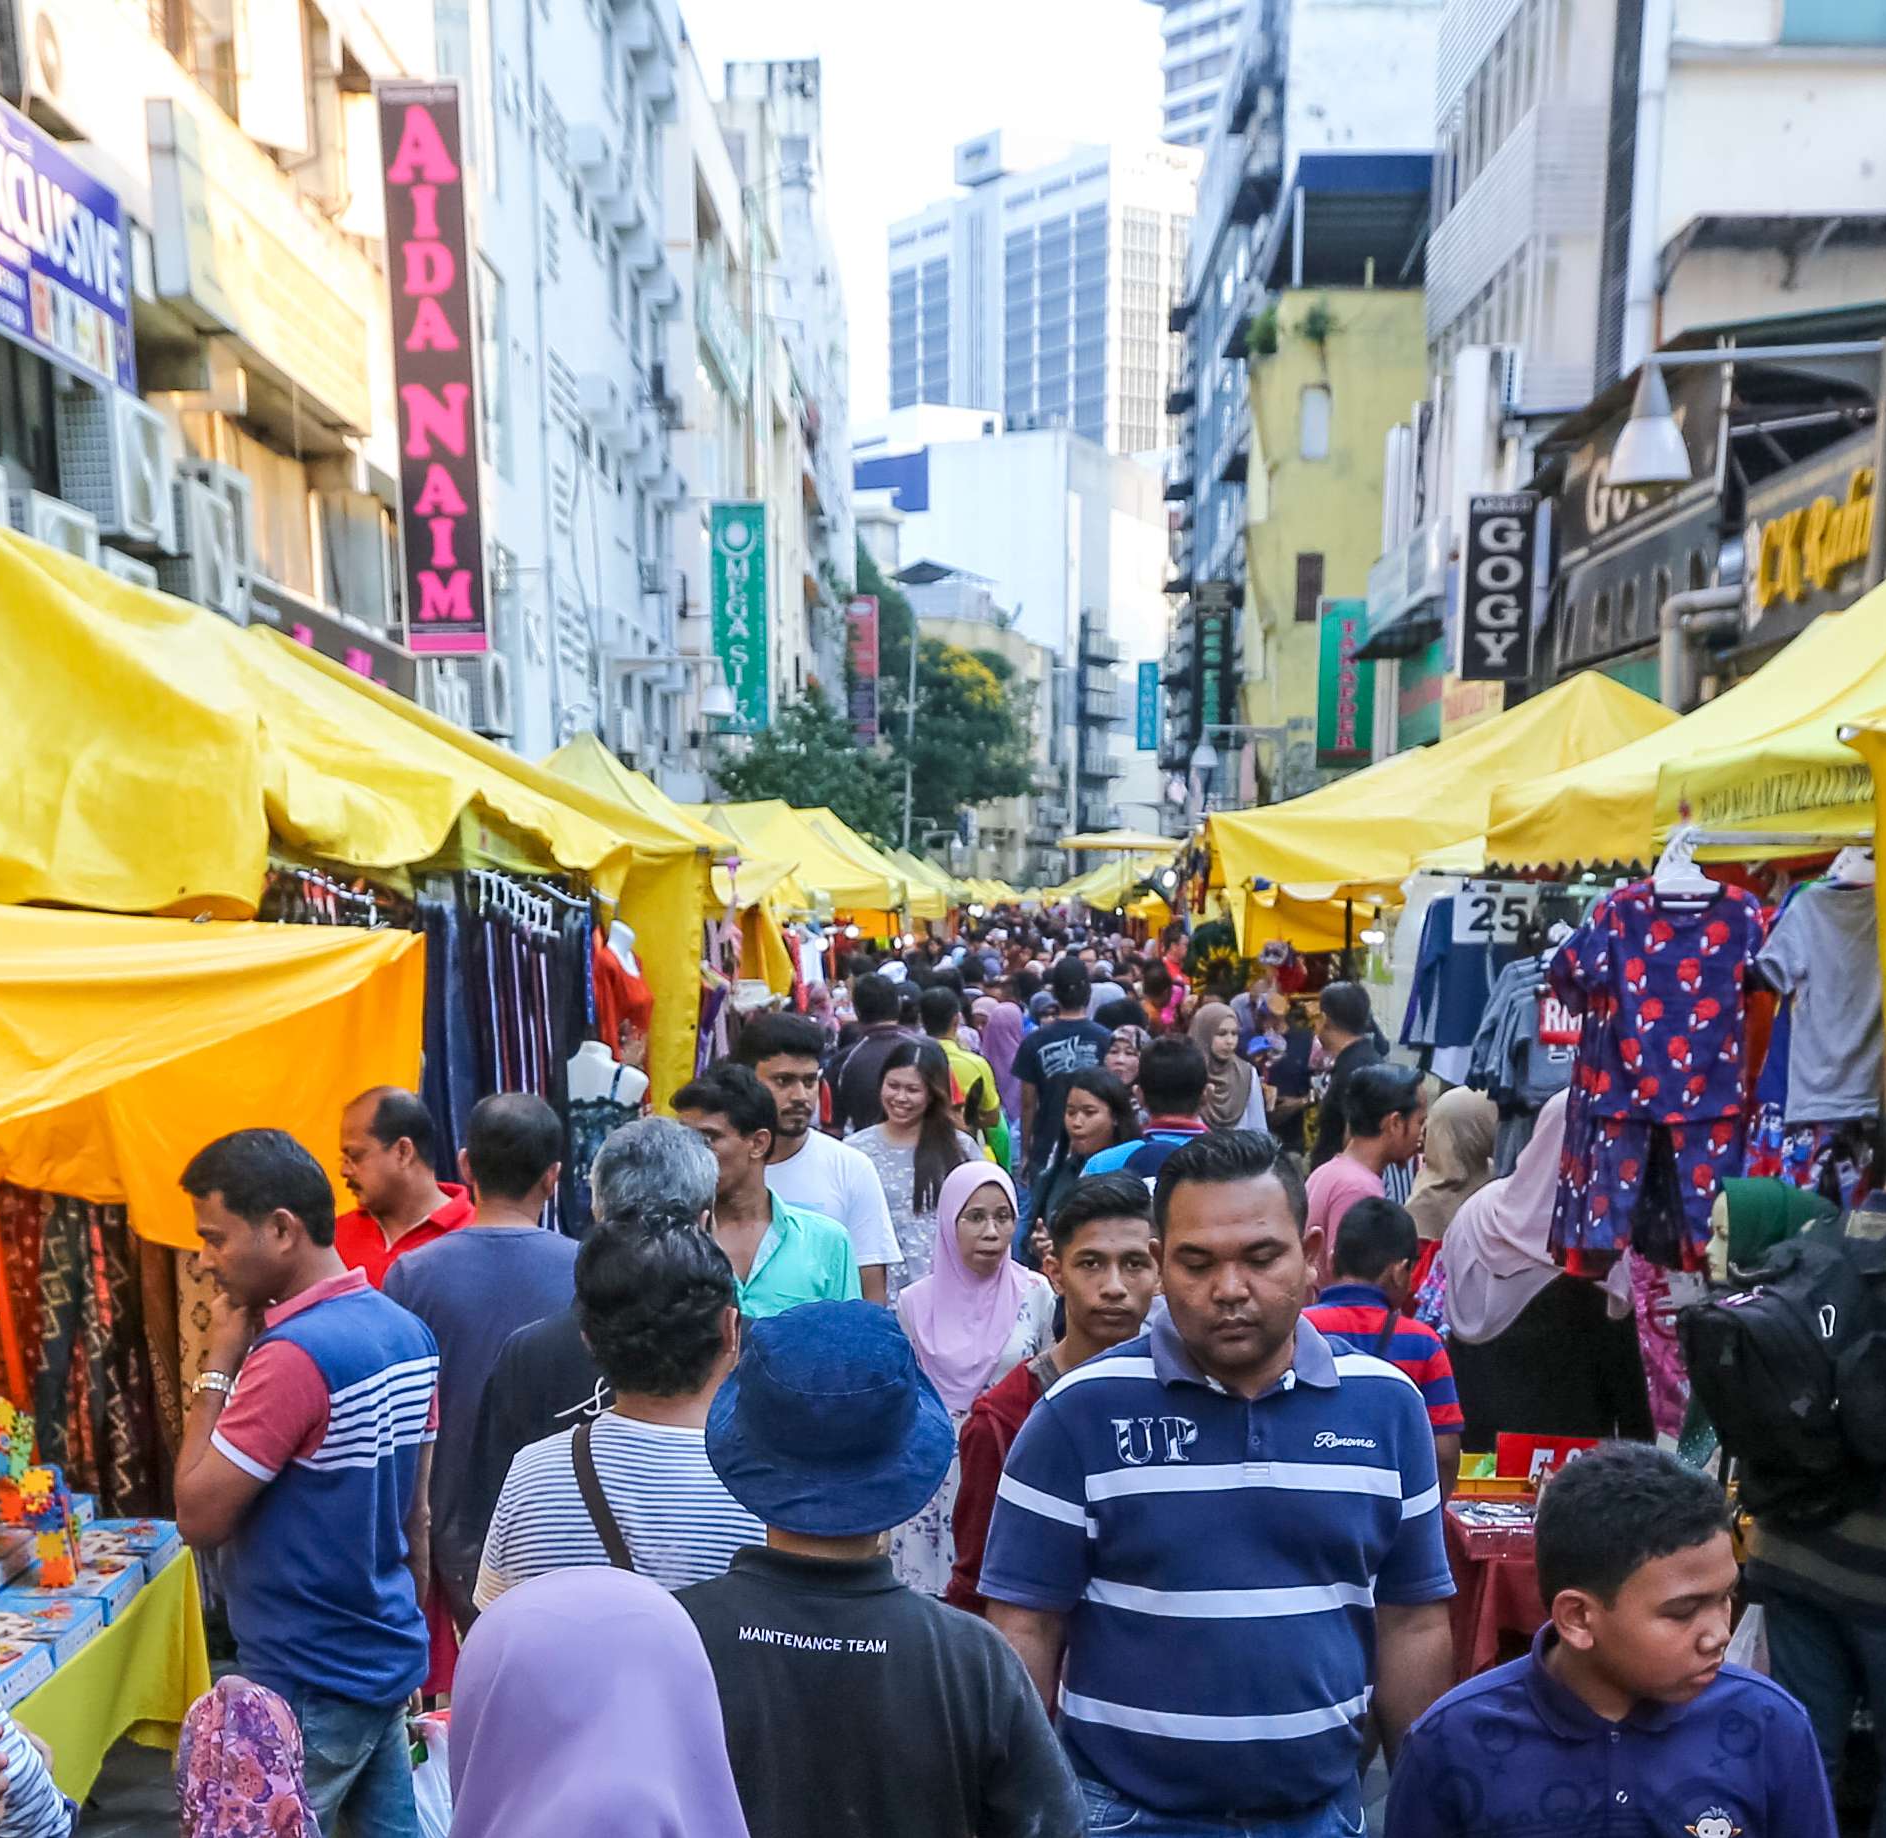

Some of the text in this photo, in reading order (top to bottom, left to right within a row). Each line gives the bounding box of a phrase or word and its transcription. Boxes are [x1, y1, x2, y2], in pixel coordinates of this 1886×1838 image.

[387, 102, 461, 353] AIDA
[399, 382, 476, 623] NAIM
[1473, 516, 1527, 667] GOGY
[1468, 896, 1528, 933] 25
[1544, 996, 1583, 1032] RM
[1110, 1416, 1199, 1466] UP
[738, 1625, 888, 1654] MAINTENANCE TEAM
